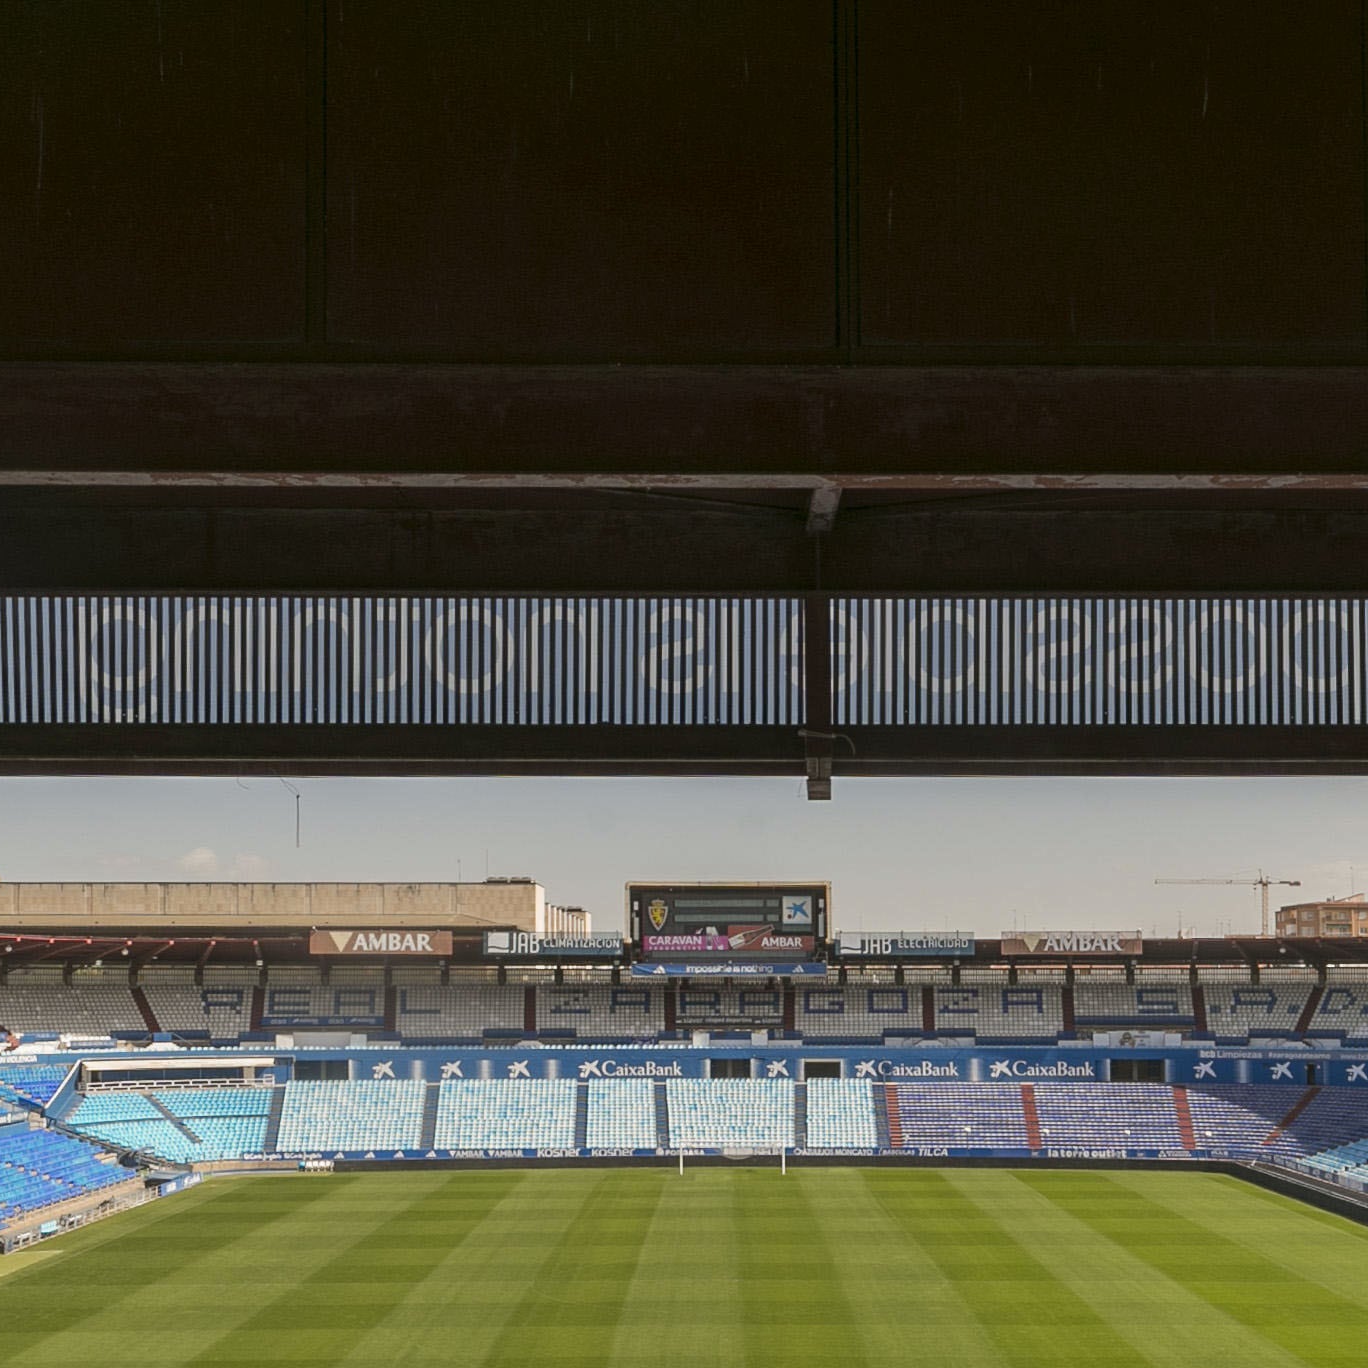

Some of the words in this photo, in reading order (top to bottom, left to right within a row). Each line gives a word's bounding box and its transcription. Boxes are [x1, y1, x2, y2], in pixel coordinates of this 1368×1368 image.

[352, 932, 433, 952] AMBAR
[510, 932, 540, 954] JAB
[648, 935, 703, 945] CARAVAN
[761, 937, 803, 948] AMBAR
[862, 935, 892, 955] JAB
[897, 936, 969, 949] ELECTRICIDAD
[1043, 934, 1122, 952] AMBAR
[1217, 1050, 1263, 1060] Limpiezas
[601, 1060, 682, 1077] CaixaBank
[878, 1060, 959, 1078] CaixaBank
[1011, 1060, 1095, 1078] CaixaBank
[455, 1150, 483, 1158] AMBAR
[495, 1150, 523, 1158] AMBAR
[918, 1149, 949, 1157] TILCA
[1047, 1149, 1059, 1158] la
[1060, 1149, 1090, 1158] torre
